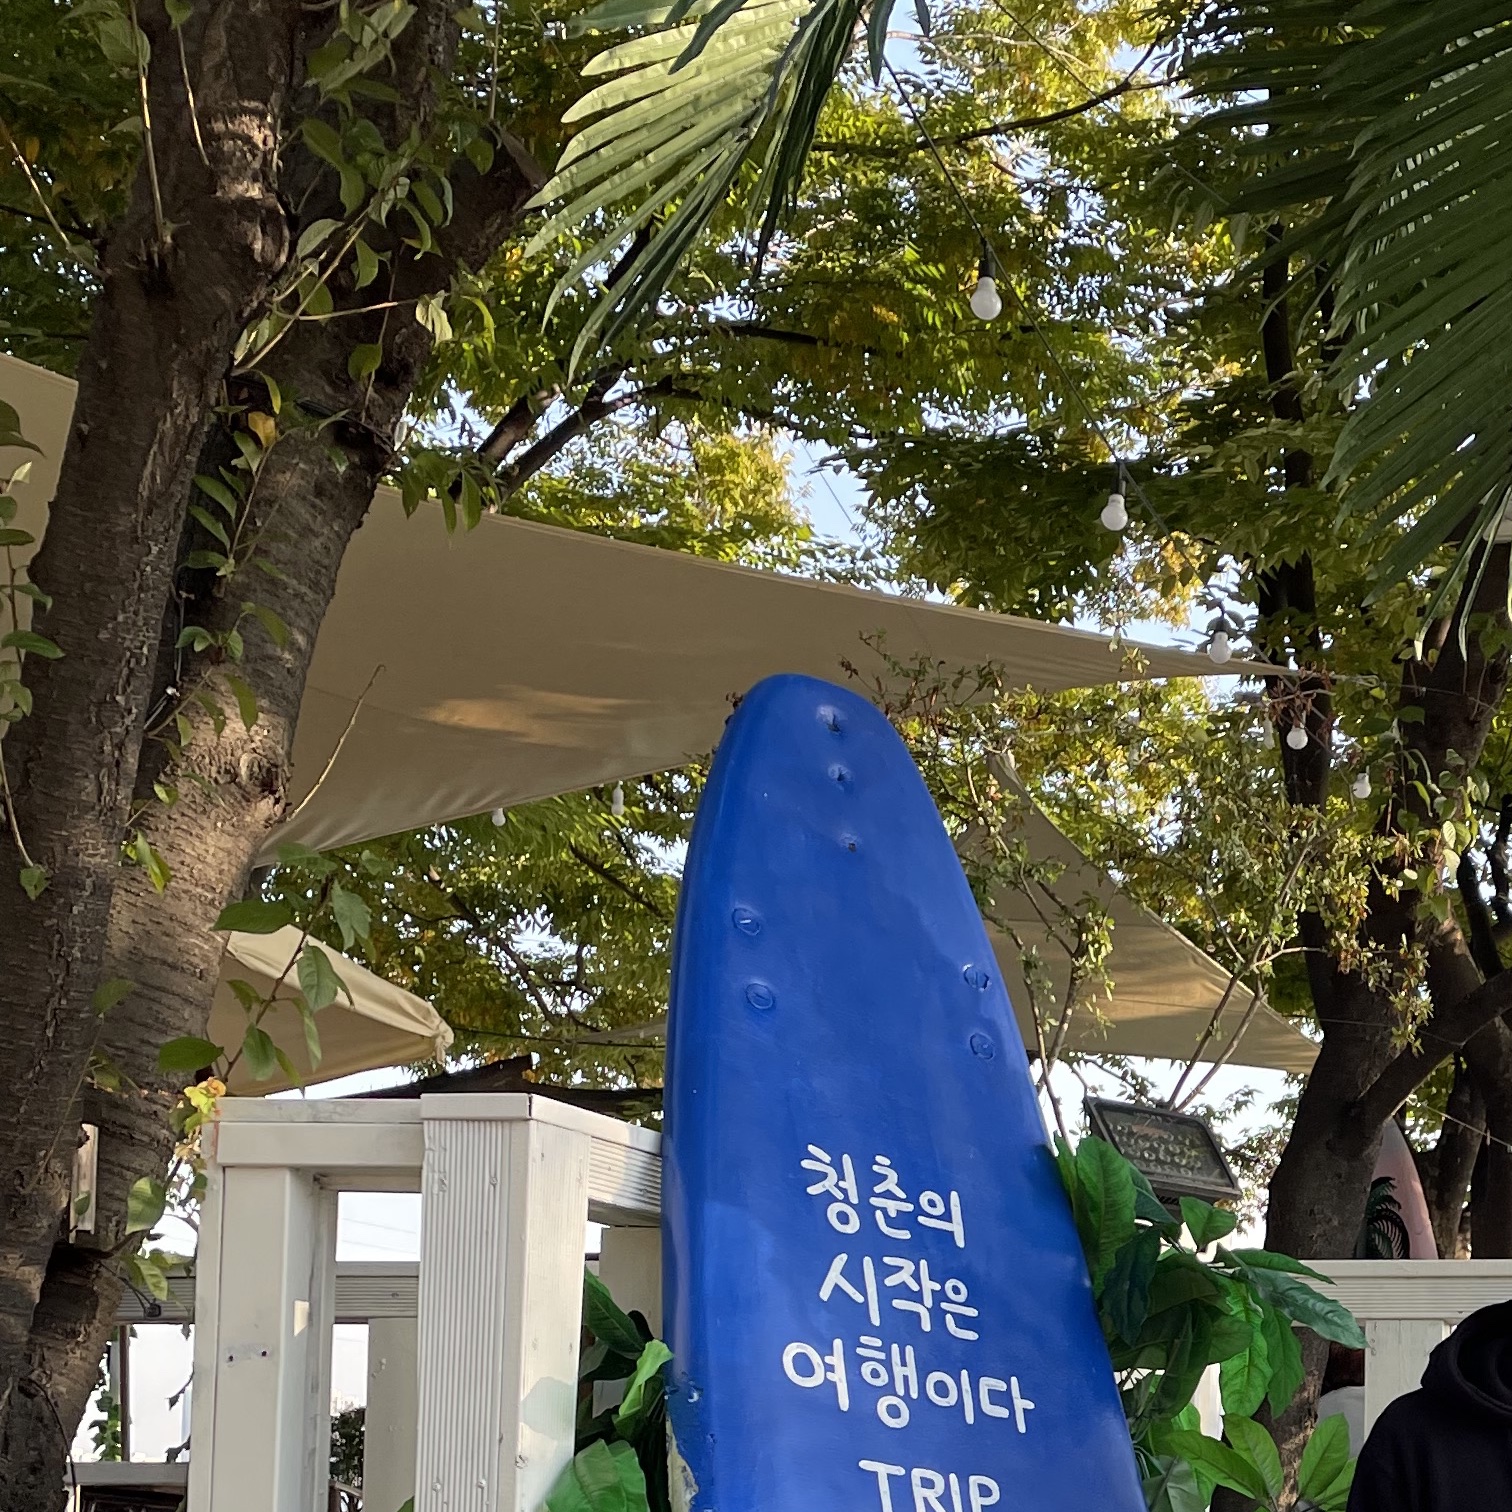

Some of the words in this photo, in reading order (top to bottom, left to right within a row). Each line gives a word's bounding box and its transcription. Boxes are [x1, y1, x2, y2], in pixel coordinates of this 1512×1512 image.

[801, 1145, 964, 1248] 청춘의
[819, 1253, 979, 1341] 시작은
[782, 1335, 1035, 1433] 여행이다
